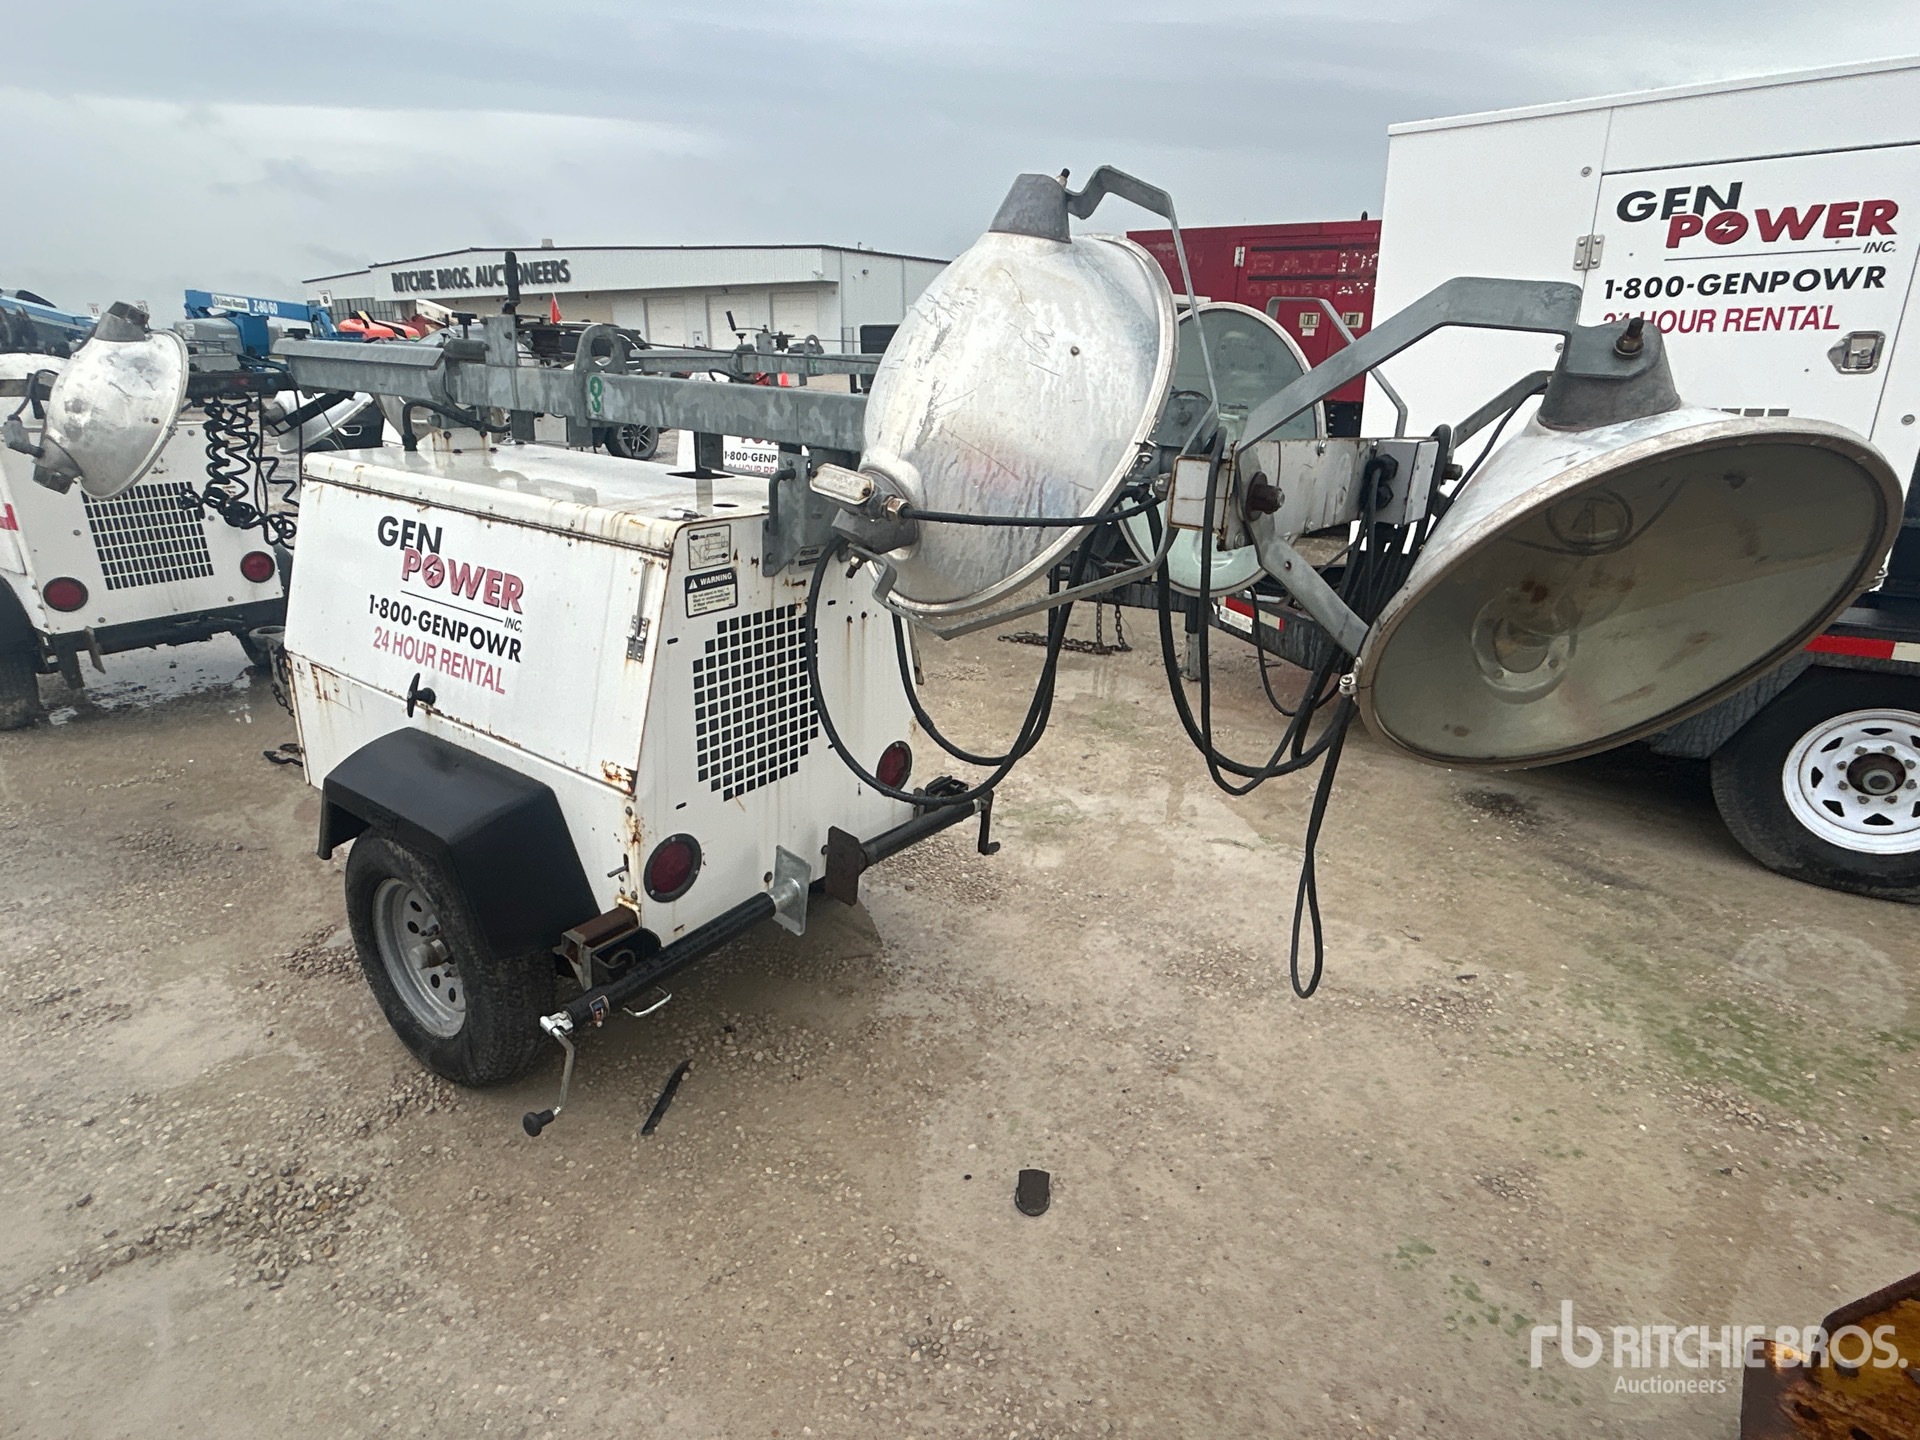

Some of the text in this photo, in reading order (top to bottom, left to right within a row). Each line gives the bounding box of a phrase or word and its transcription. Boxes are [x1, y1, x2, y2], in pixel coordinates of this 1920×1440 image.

[1616, 181, 1743, 223] GEN
[1665, 199, 1899, 249] POWER
[1863, 240, 1897, 254] INC.
[391, 259, 571, 292] RITCHIE BROS. AUCTONEERS
[1605, 265, 1886, 300] 1-800-GENPOWR
[1722, 305, 1840, 333] RENTAL
[724, 451, 777, 463] 1-800-GENP
[377, 515, 443, 555] GEN
[401, 547, 524, 615] POWER
[700, 572, 732, 586] WARNING
[369, 594, 522, 664] 1-800-GENPOWR
[504, 616, 524, 633] INC.
[373, 626, 506, 695] 24 HOUR RENTAL
